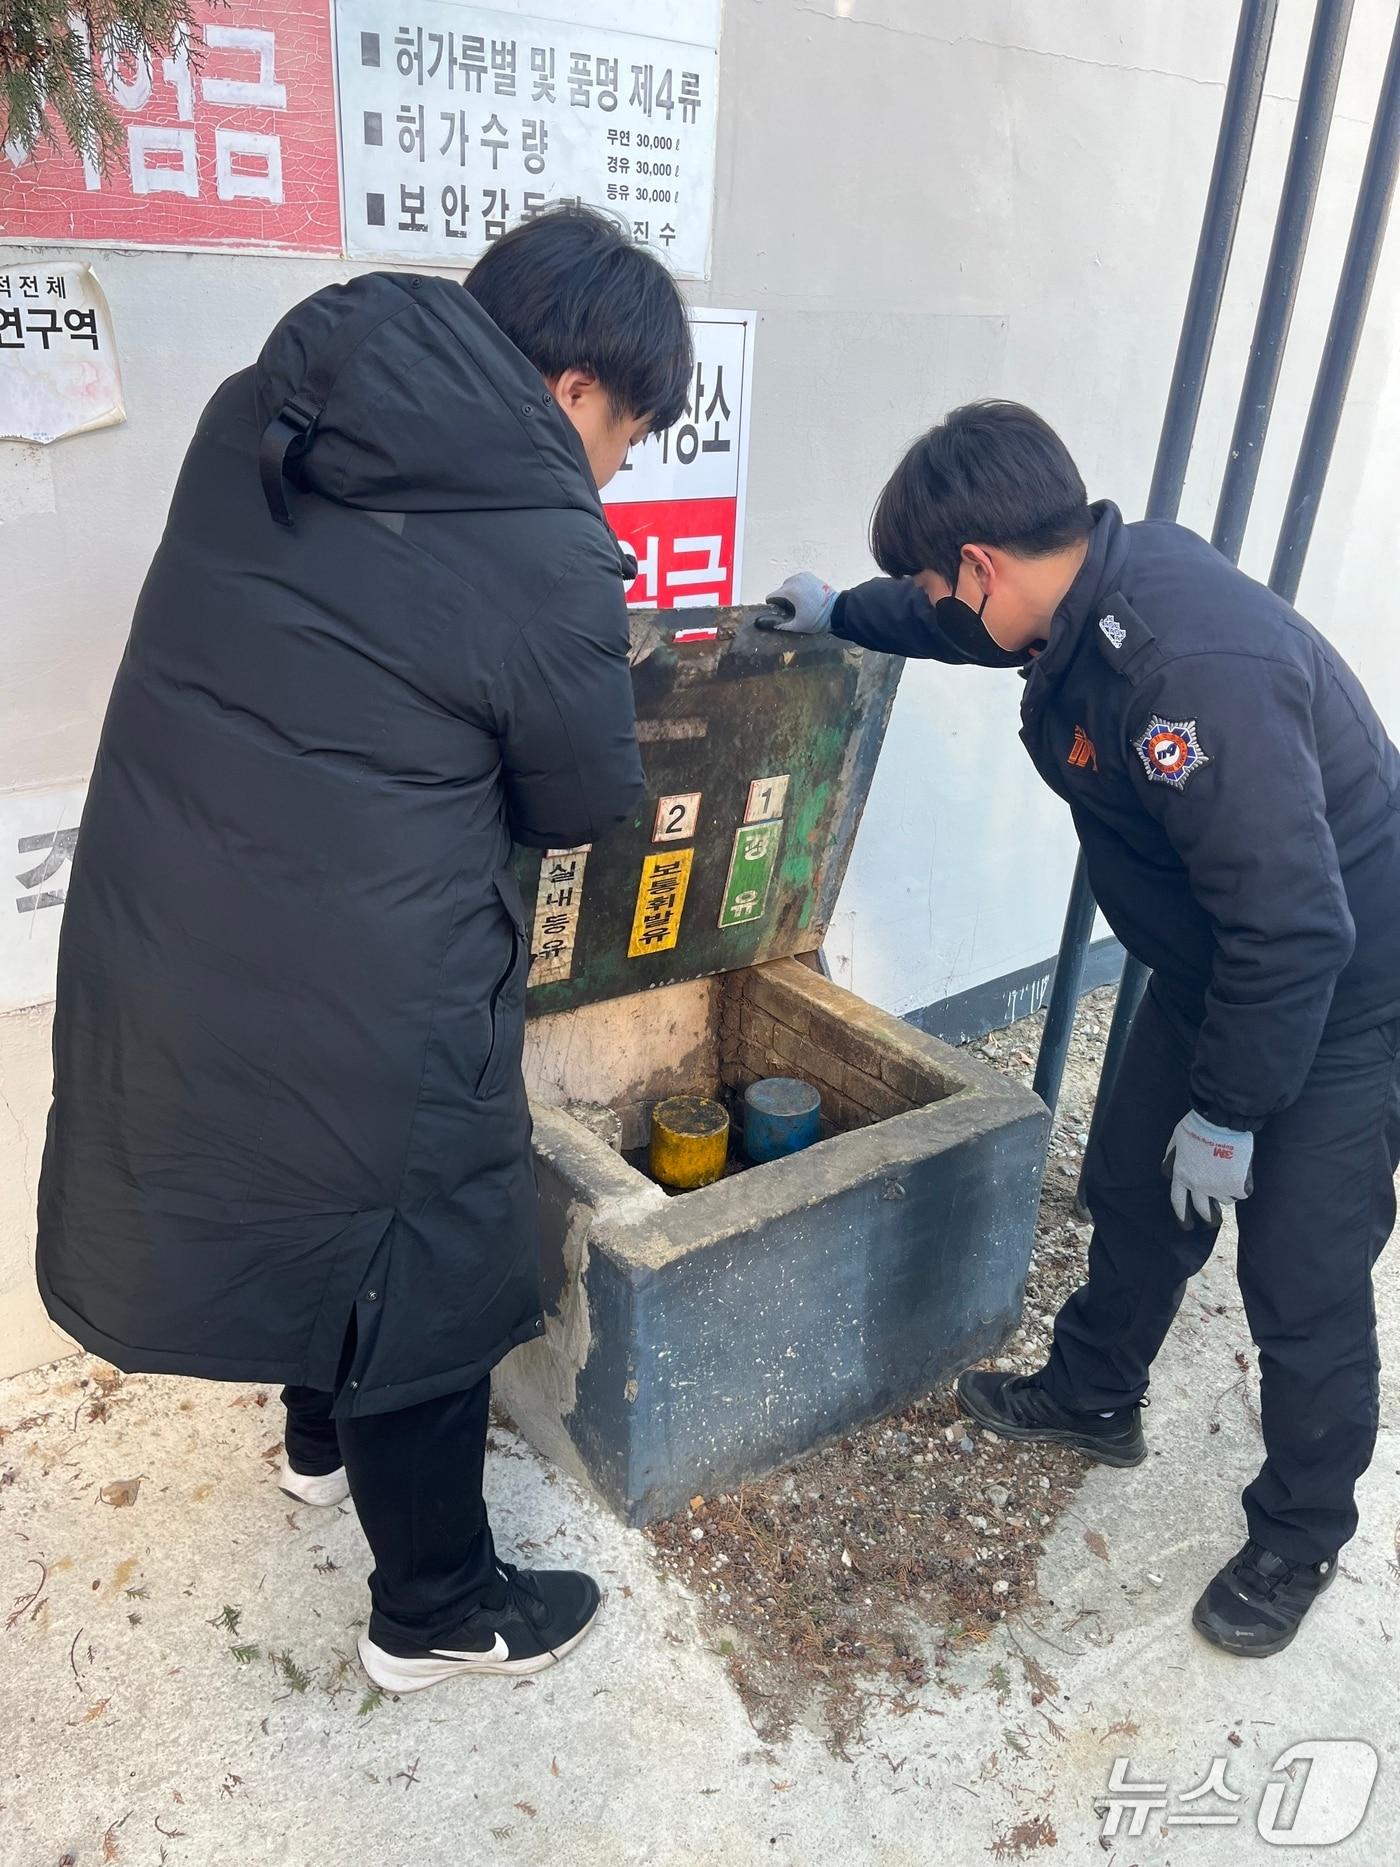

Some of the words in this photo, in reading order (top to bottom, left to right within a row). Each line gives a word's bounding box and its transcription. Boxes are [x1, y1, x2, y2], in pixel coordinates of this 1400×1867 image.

[394, 26, 516, 96] 허가류별
[530, 47, 556, 104] 및
[567, 52, 618, 112] 품명
[606, 129, 631, 147] 무연
[636, 131, 673, 150] 30,000
[607, 156, 630, 174] 경유
[636, 158, 673, 177] 30,000
[607, 183, 630, 201] 등유
[636, 185, 672, 203] 30,000
[761, 787, 773, 813] 1
[665, 804, 686, 834] 2
[531, 861, 576, 959] 실내등유
[638, 860, 682, 945] 보통휘발유
